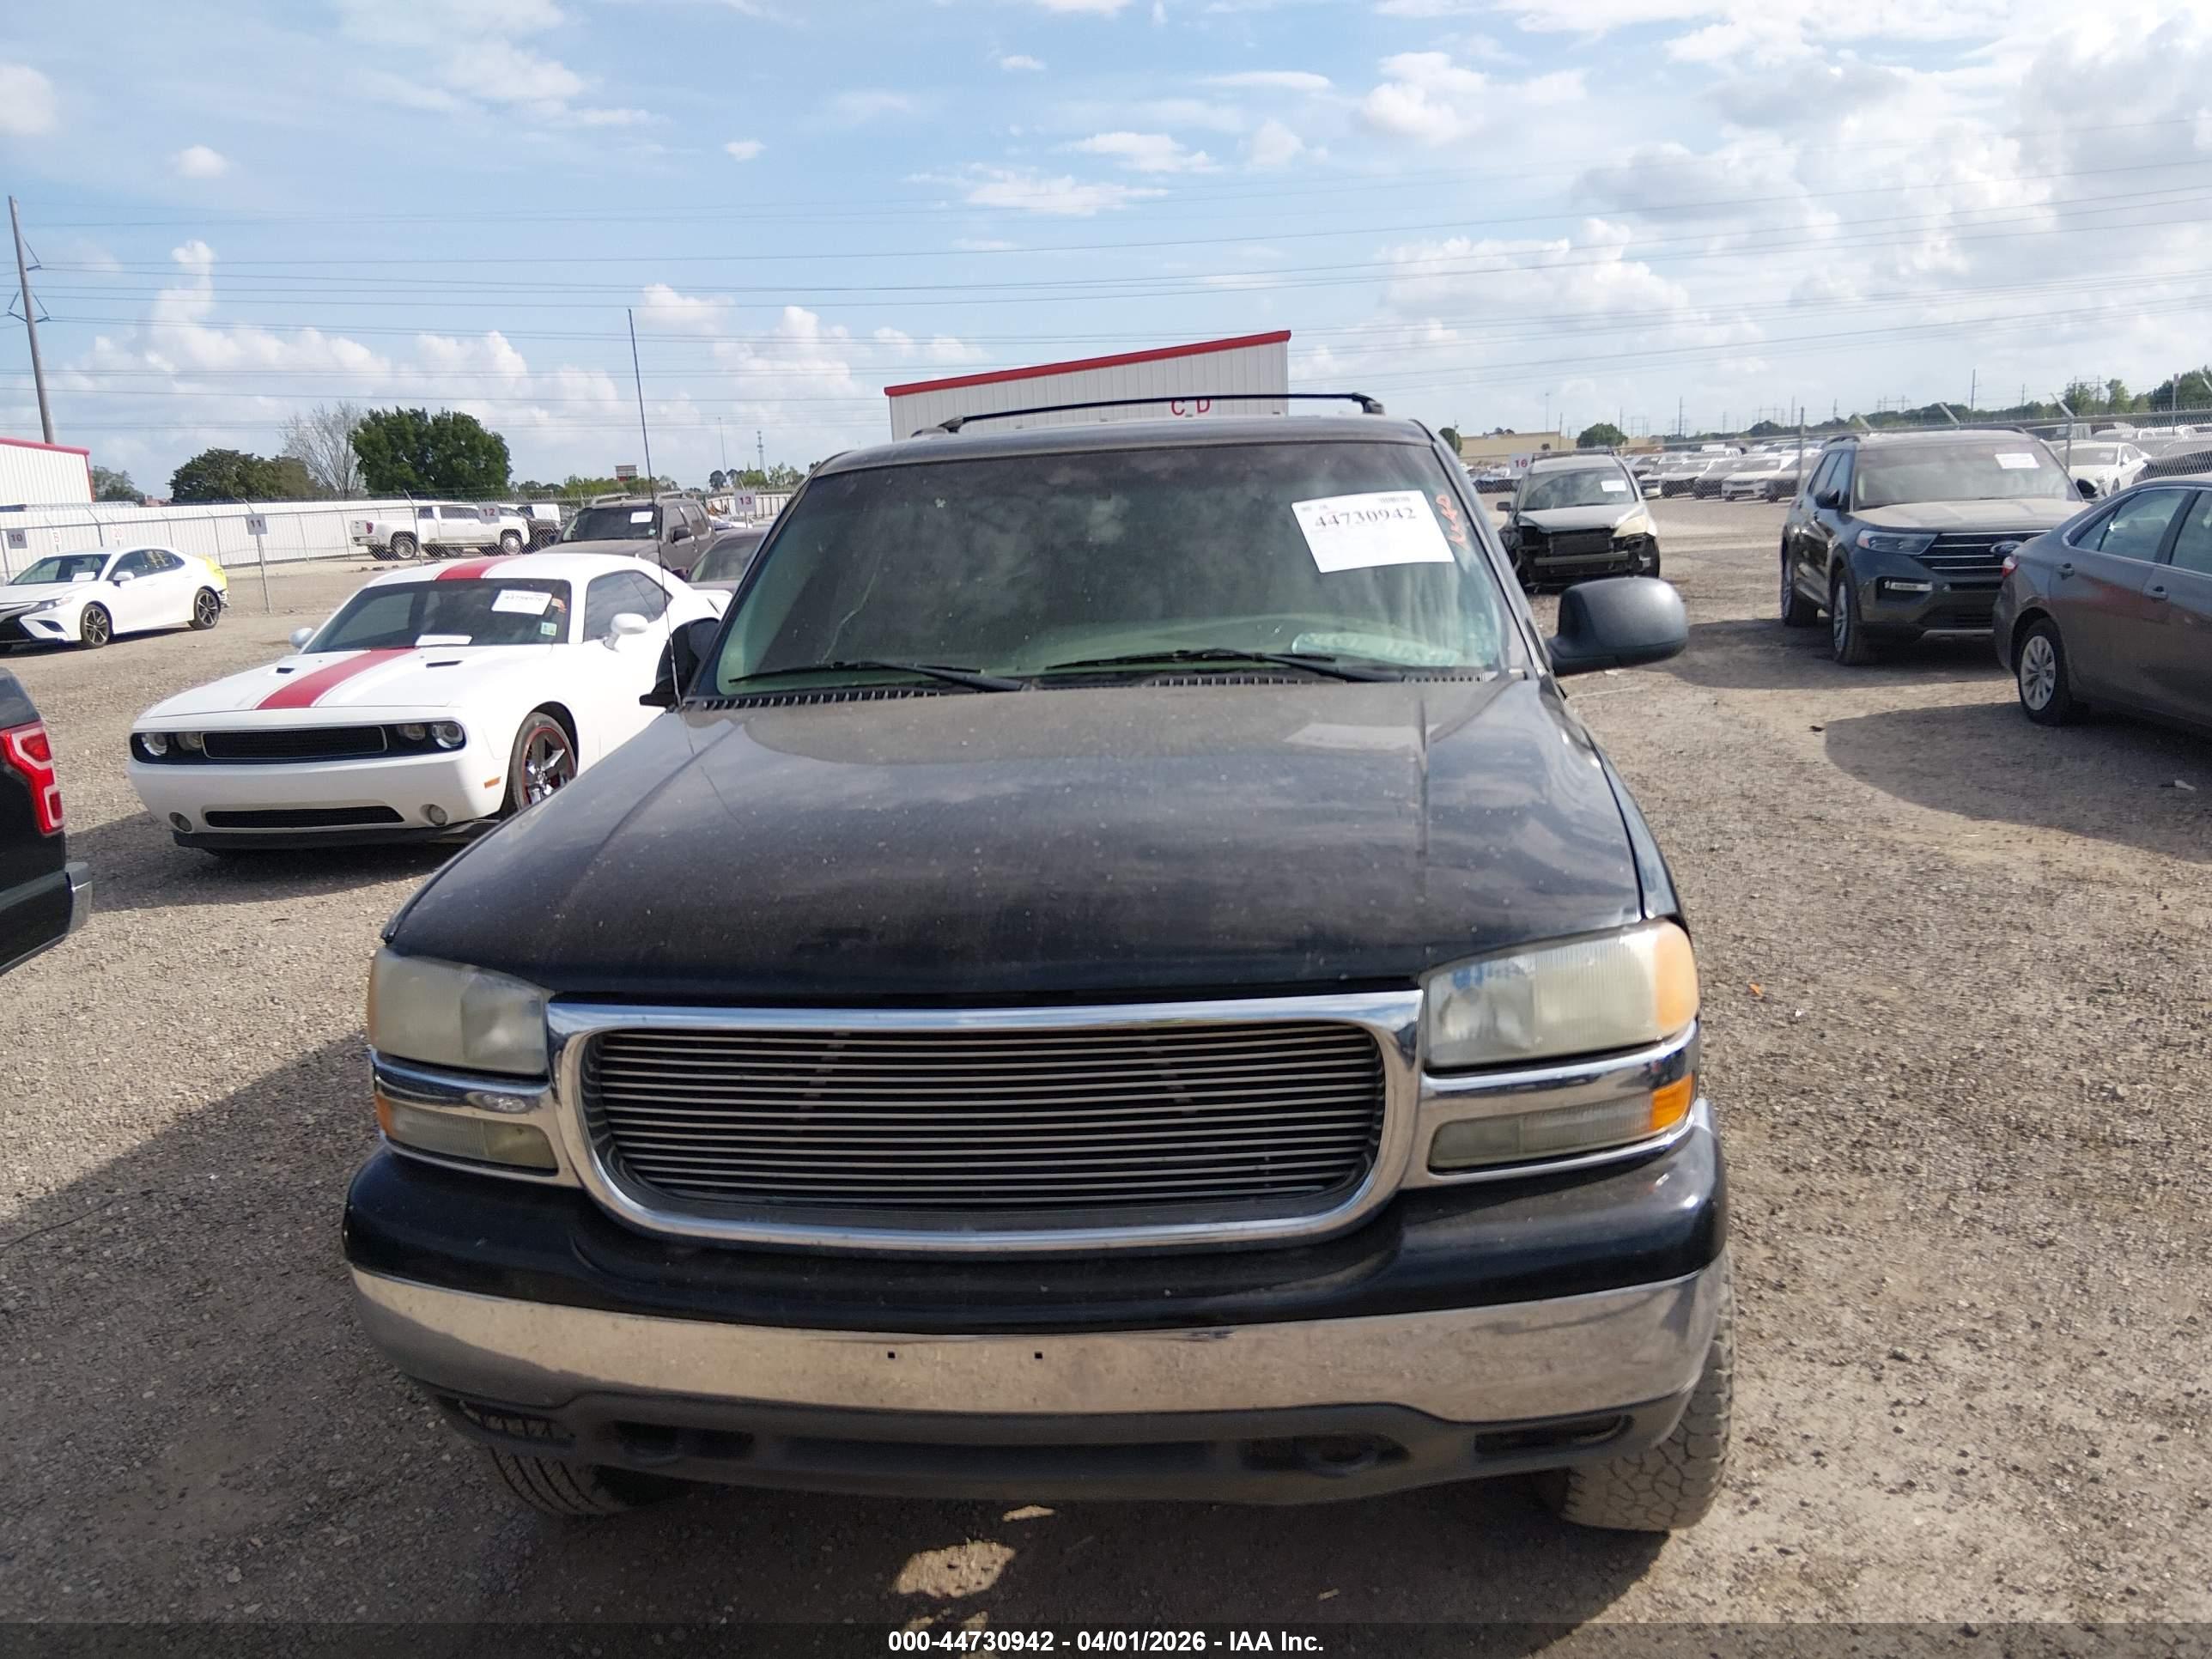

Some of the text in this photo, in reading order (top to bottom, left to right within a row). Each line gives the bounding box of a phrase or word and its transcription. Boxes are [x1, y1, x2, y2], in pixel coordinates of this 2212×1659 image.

[739, 496, 752, 505] 13
[1315, 507, 1417, 528] 44730942
[250, 520, 261, 528] 11
[11, 533, 22, 542] 10
